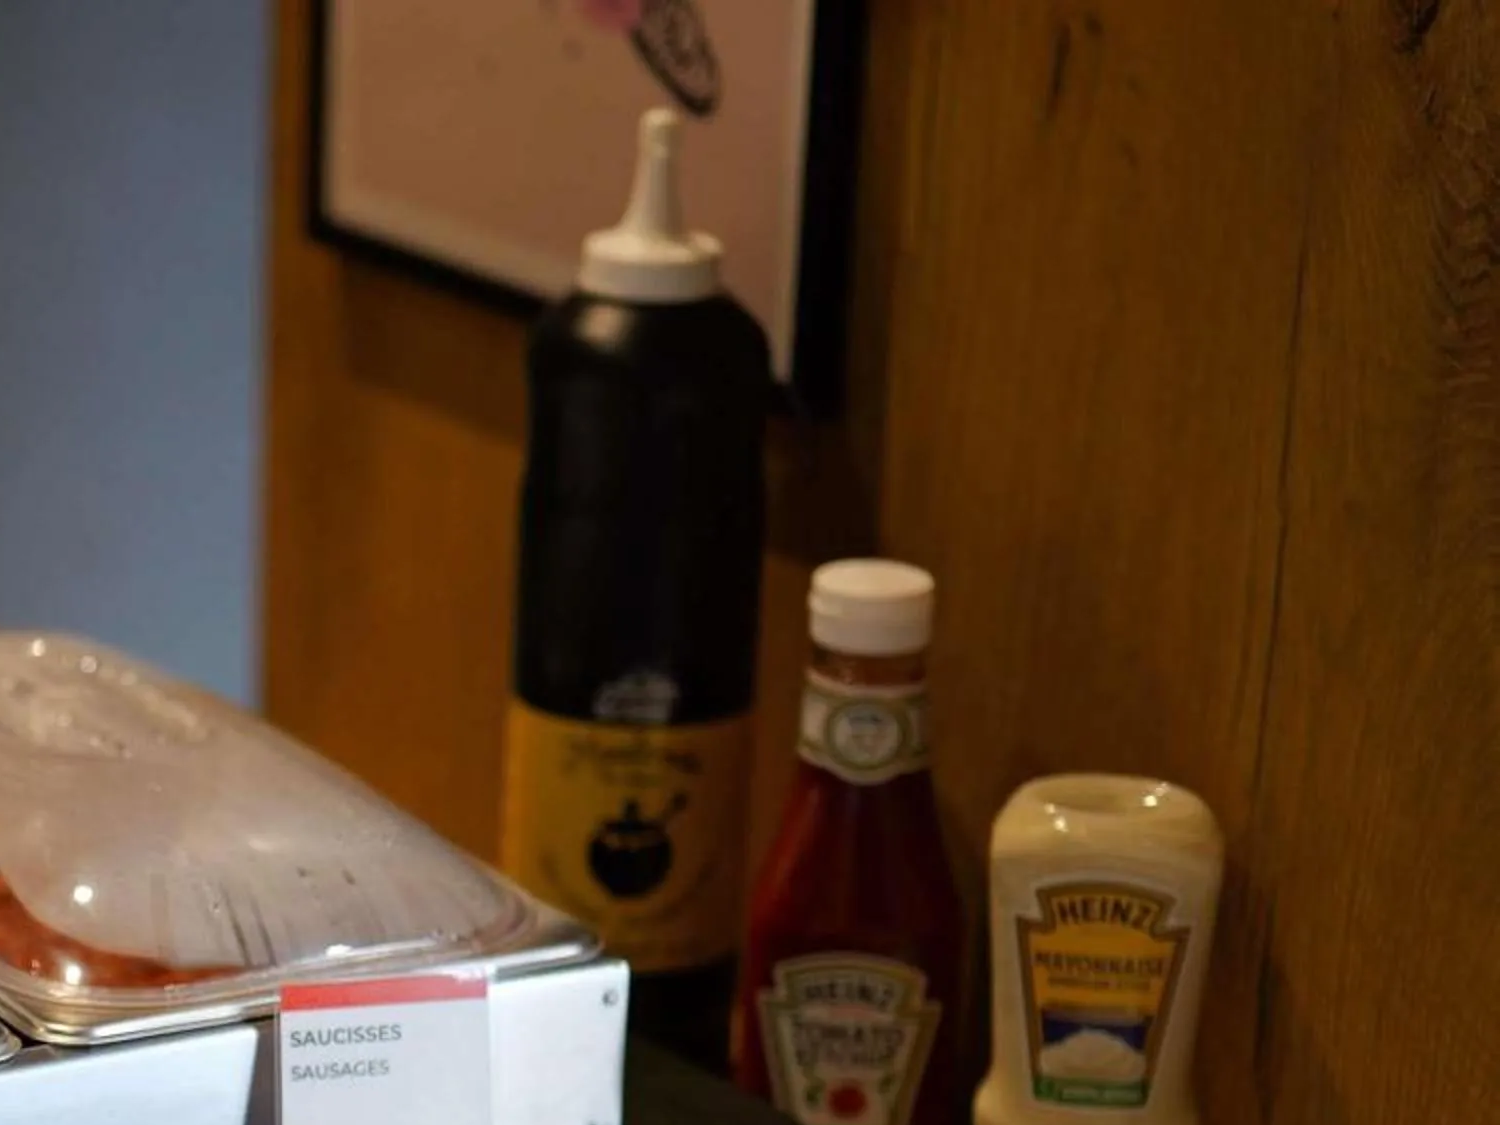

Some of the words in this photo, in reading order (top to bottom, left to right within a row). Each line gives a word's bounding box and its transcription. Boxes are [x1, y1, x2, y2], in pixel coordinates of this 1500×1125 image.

[1057, 896, 1159, 929] HEINZ
[290, 1024, 402, 1048] SAUCISSES
[291, 1060, 389, 1081] SAUSAGES
